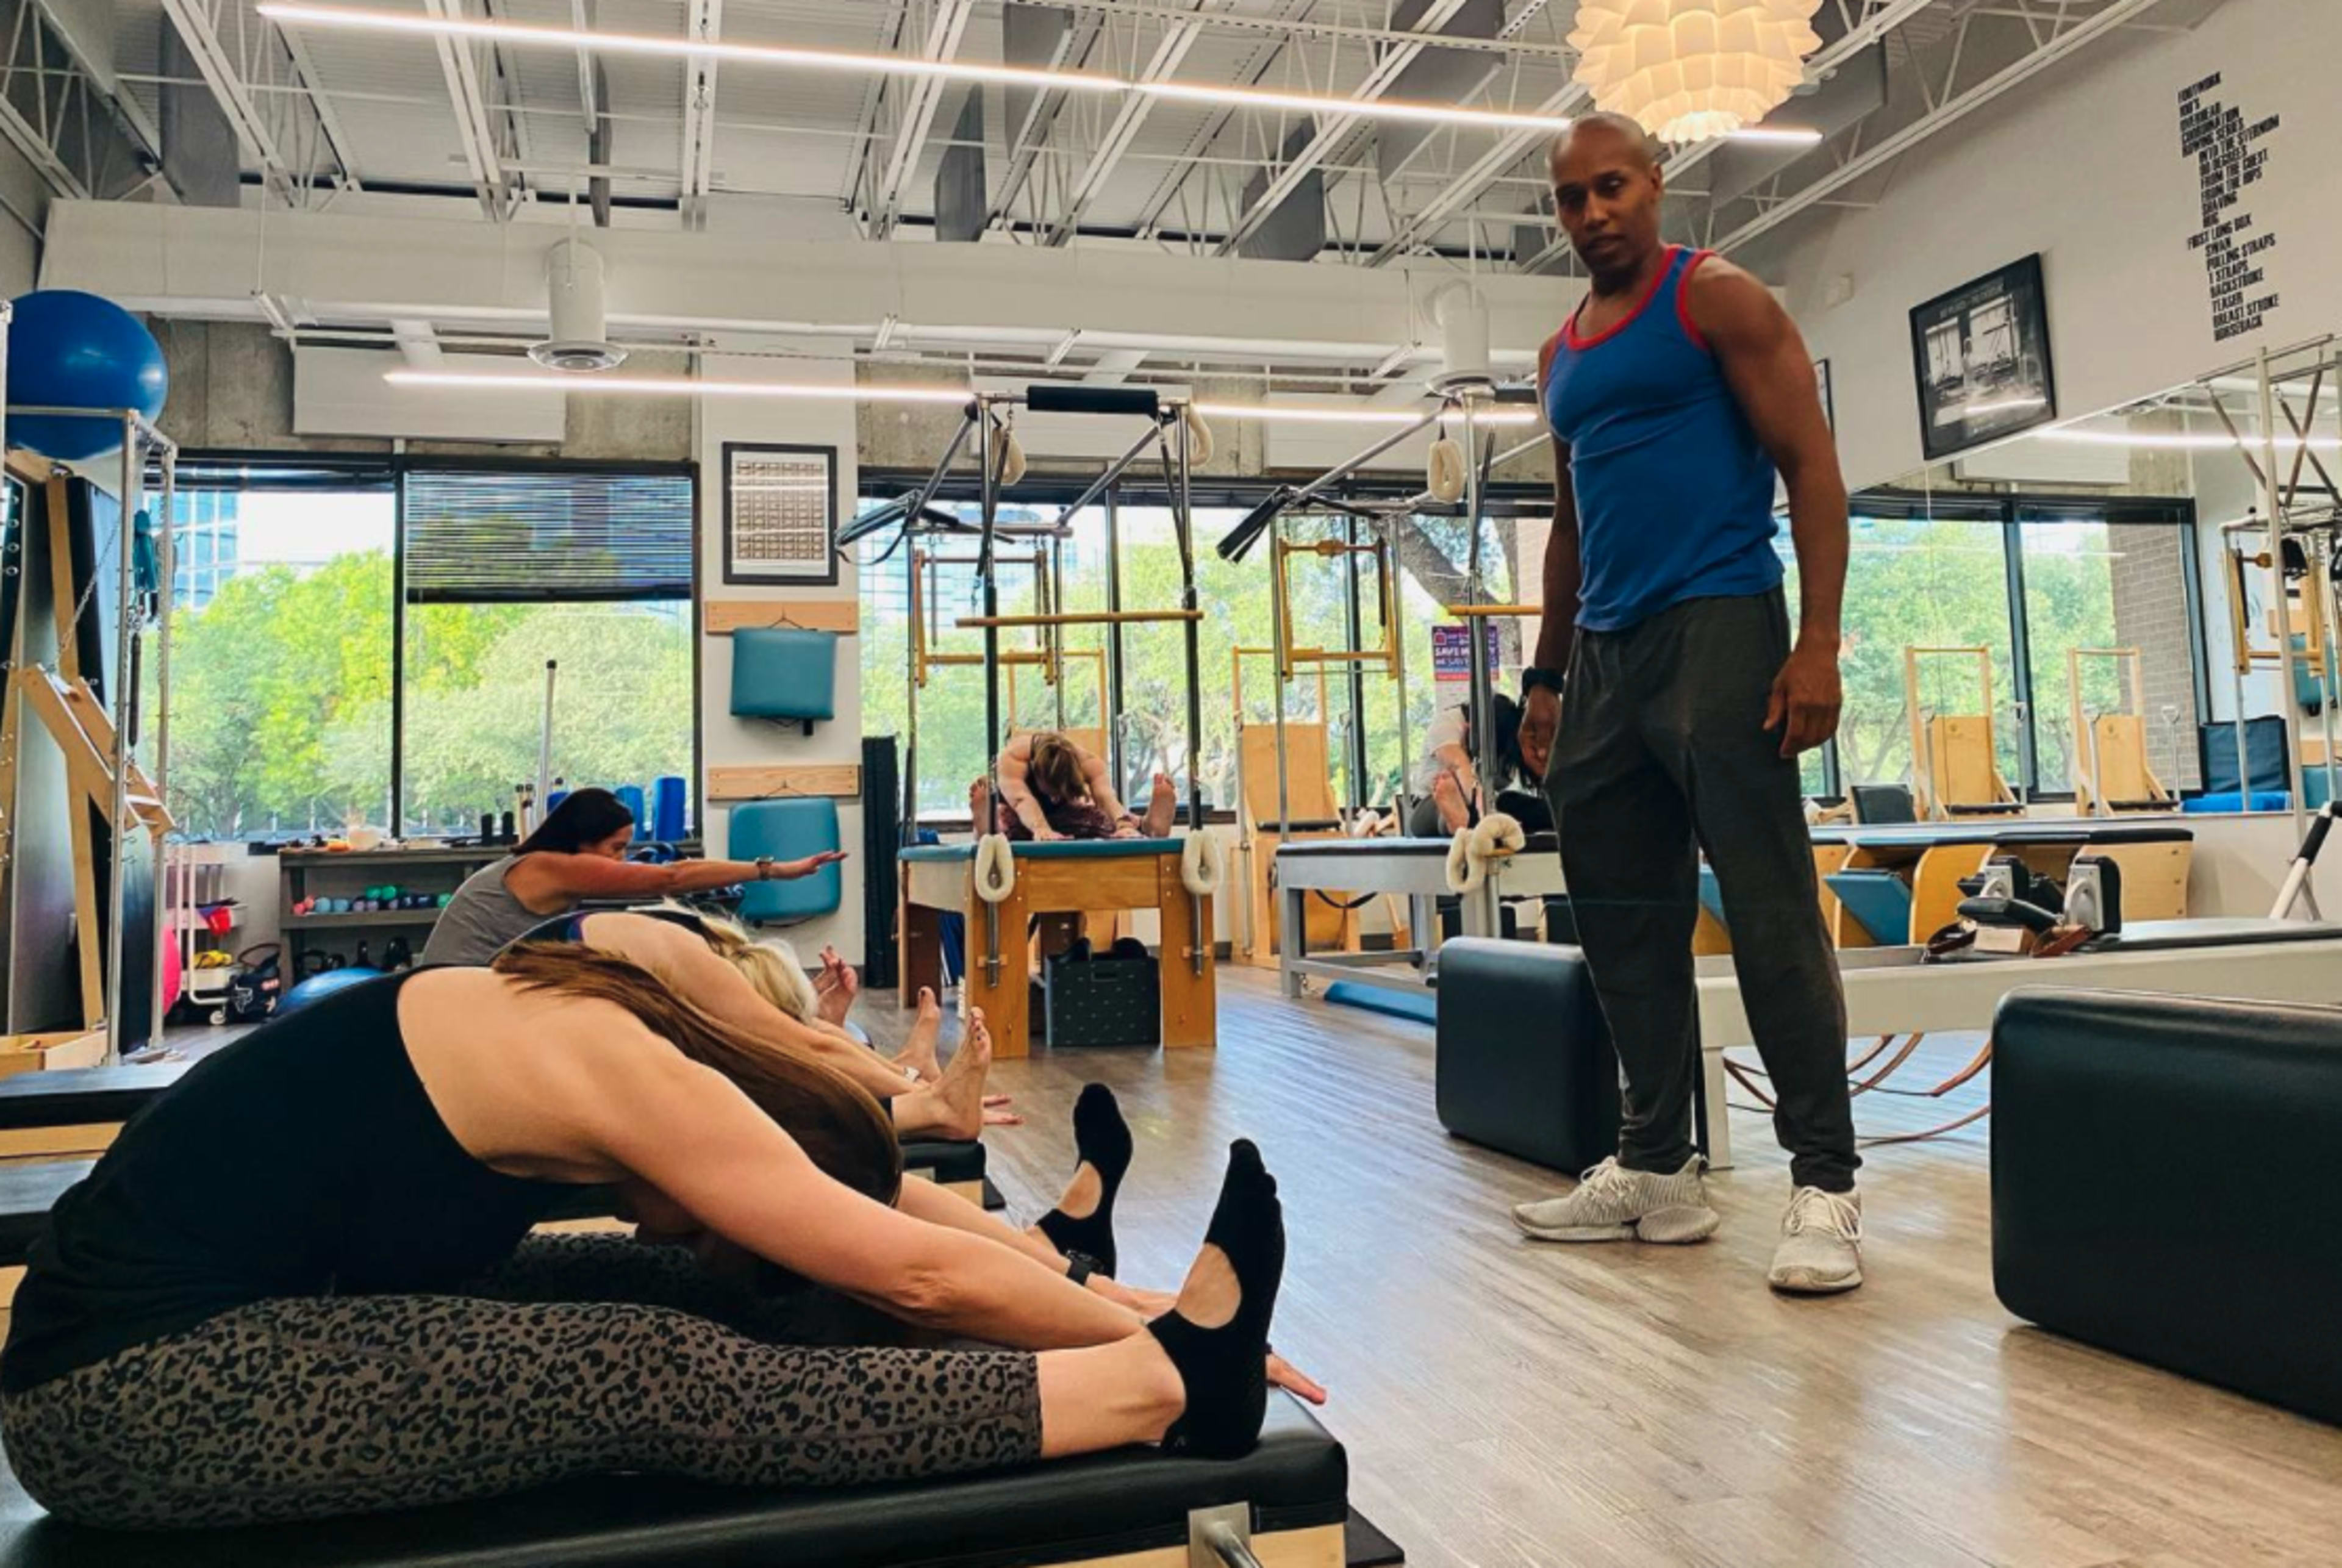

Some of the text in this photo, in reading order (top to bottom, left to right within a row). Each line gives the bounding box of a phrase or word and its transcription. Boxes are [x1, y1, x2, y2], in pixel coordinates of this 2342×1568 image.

[2219, 137, 2235, 154] THE
[2201, 148, 2268, 190] FROM THE CHEST
[2201, 182, 2224, 202] FROM
[2226, 176, 2241, 192] THE
[2188, 213, 2252, 251] FIRST LONG BOX
[2205, 235, 2232, 257] SWAN
[2207, 232, 2276, 271] PULLING STRAPS
[2210, 267, 2264, 299] BACKSTROKE
[2215, 259, 2248, 282] STRAPS
[2212, 291, 2244, 313] TEASER
[2213, 293, 2280, 328] BREAST STROKE
